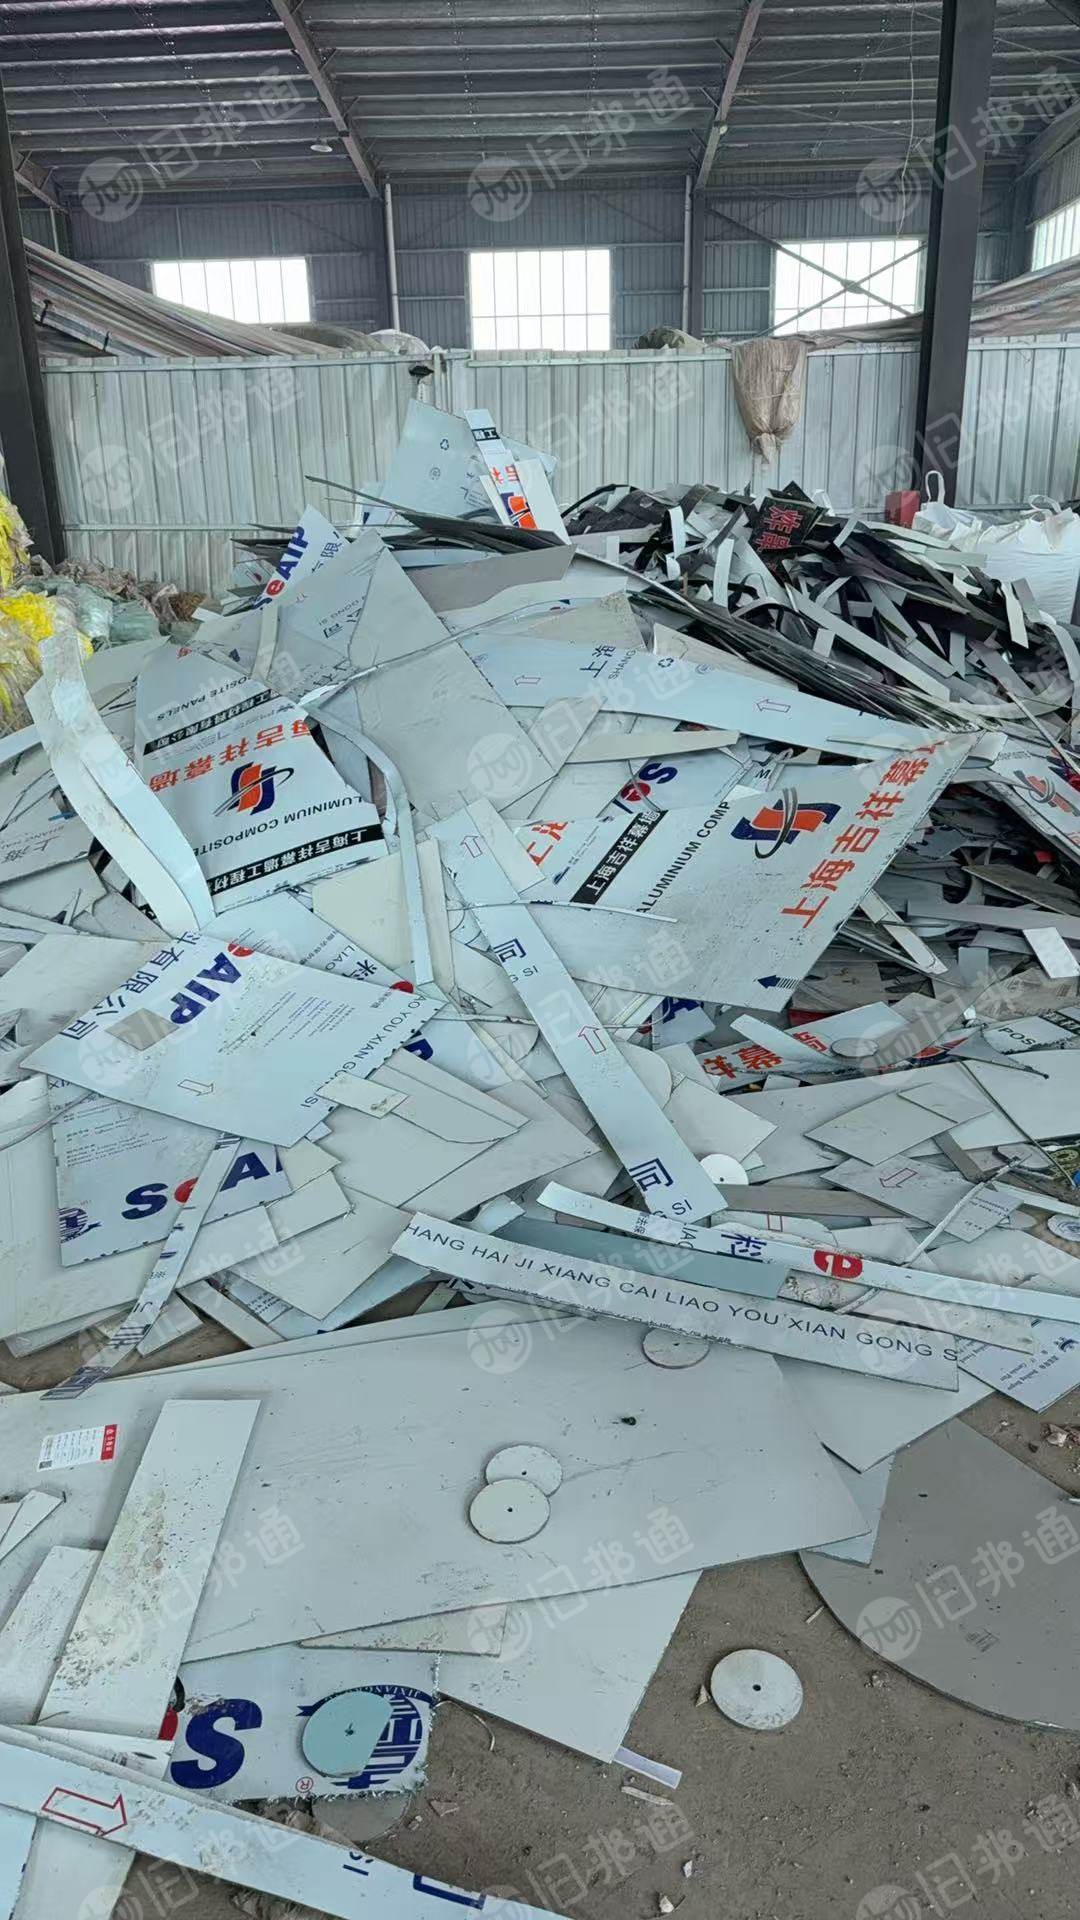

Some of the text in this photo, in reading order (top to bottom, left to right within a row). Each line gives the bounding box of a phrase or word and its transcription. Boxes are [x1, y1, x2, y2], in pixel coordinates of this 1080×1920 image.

[699, 801, 733, 839] COMP
[207, 829, 364, 892] 上海吉祥幕墙工程材
[587, 810, 660, 896] 上海吉祥幕墙
[382, 1009, 410, 1033] YOU
[354, 1032, 384, 1062] XIAN
[472, 1244, 509, 1265] HAI
[514, 1257, 534, 1271] JI
[539, 1263, 611, 1288] XIANG
[619, 1281, 657, 1300] CAI
[665, 1292, 719, 1313] LIAO
[728, 1304, 779, 1325] YOU
[787, 1315, 847, 1340] XIAN
[856, 1332, 933, 1357] GONG
